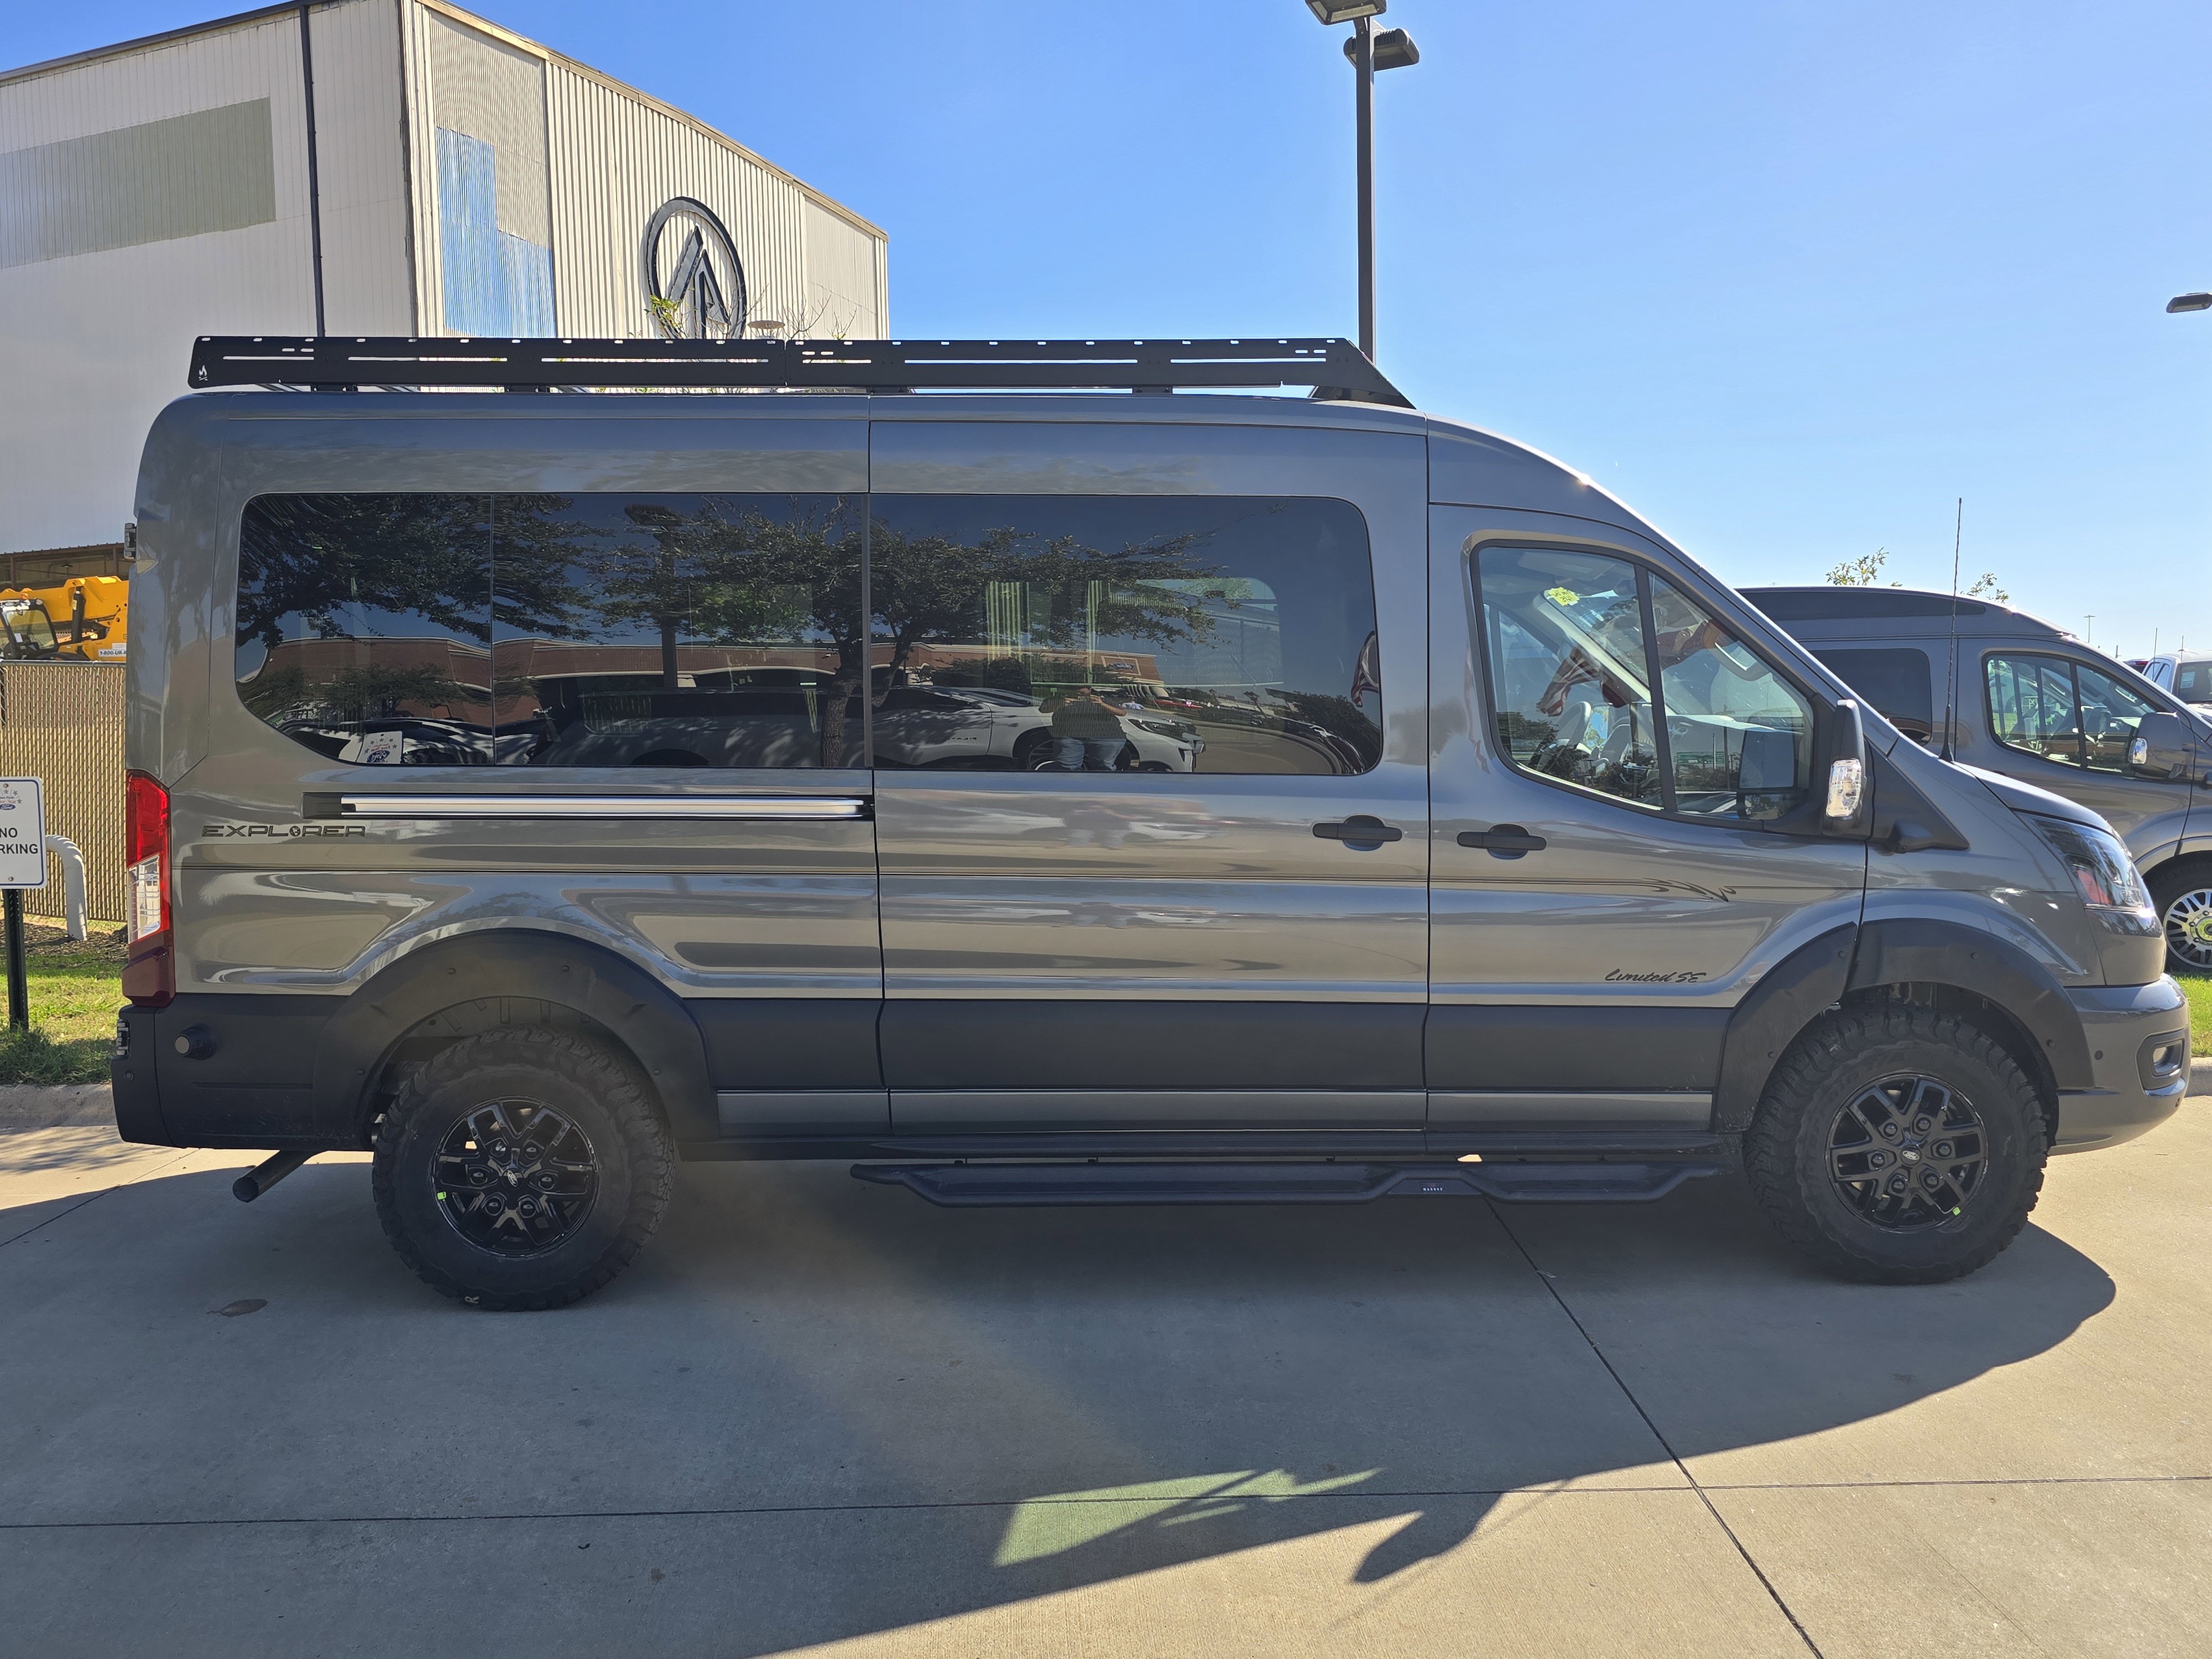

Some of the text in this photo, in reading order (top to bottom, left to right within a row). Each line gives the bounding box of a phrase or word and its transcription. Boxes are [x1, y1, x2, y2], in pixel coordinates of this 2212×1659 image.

[0, 827, 18, 838] NO
[202, 825, 366, 837] EXPLORER
[1605, 968, 1707, 983] Limited SE
